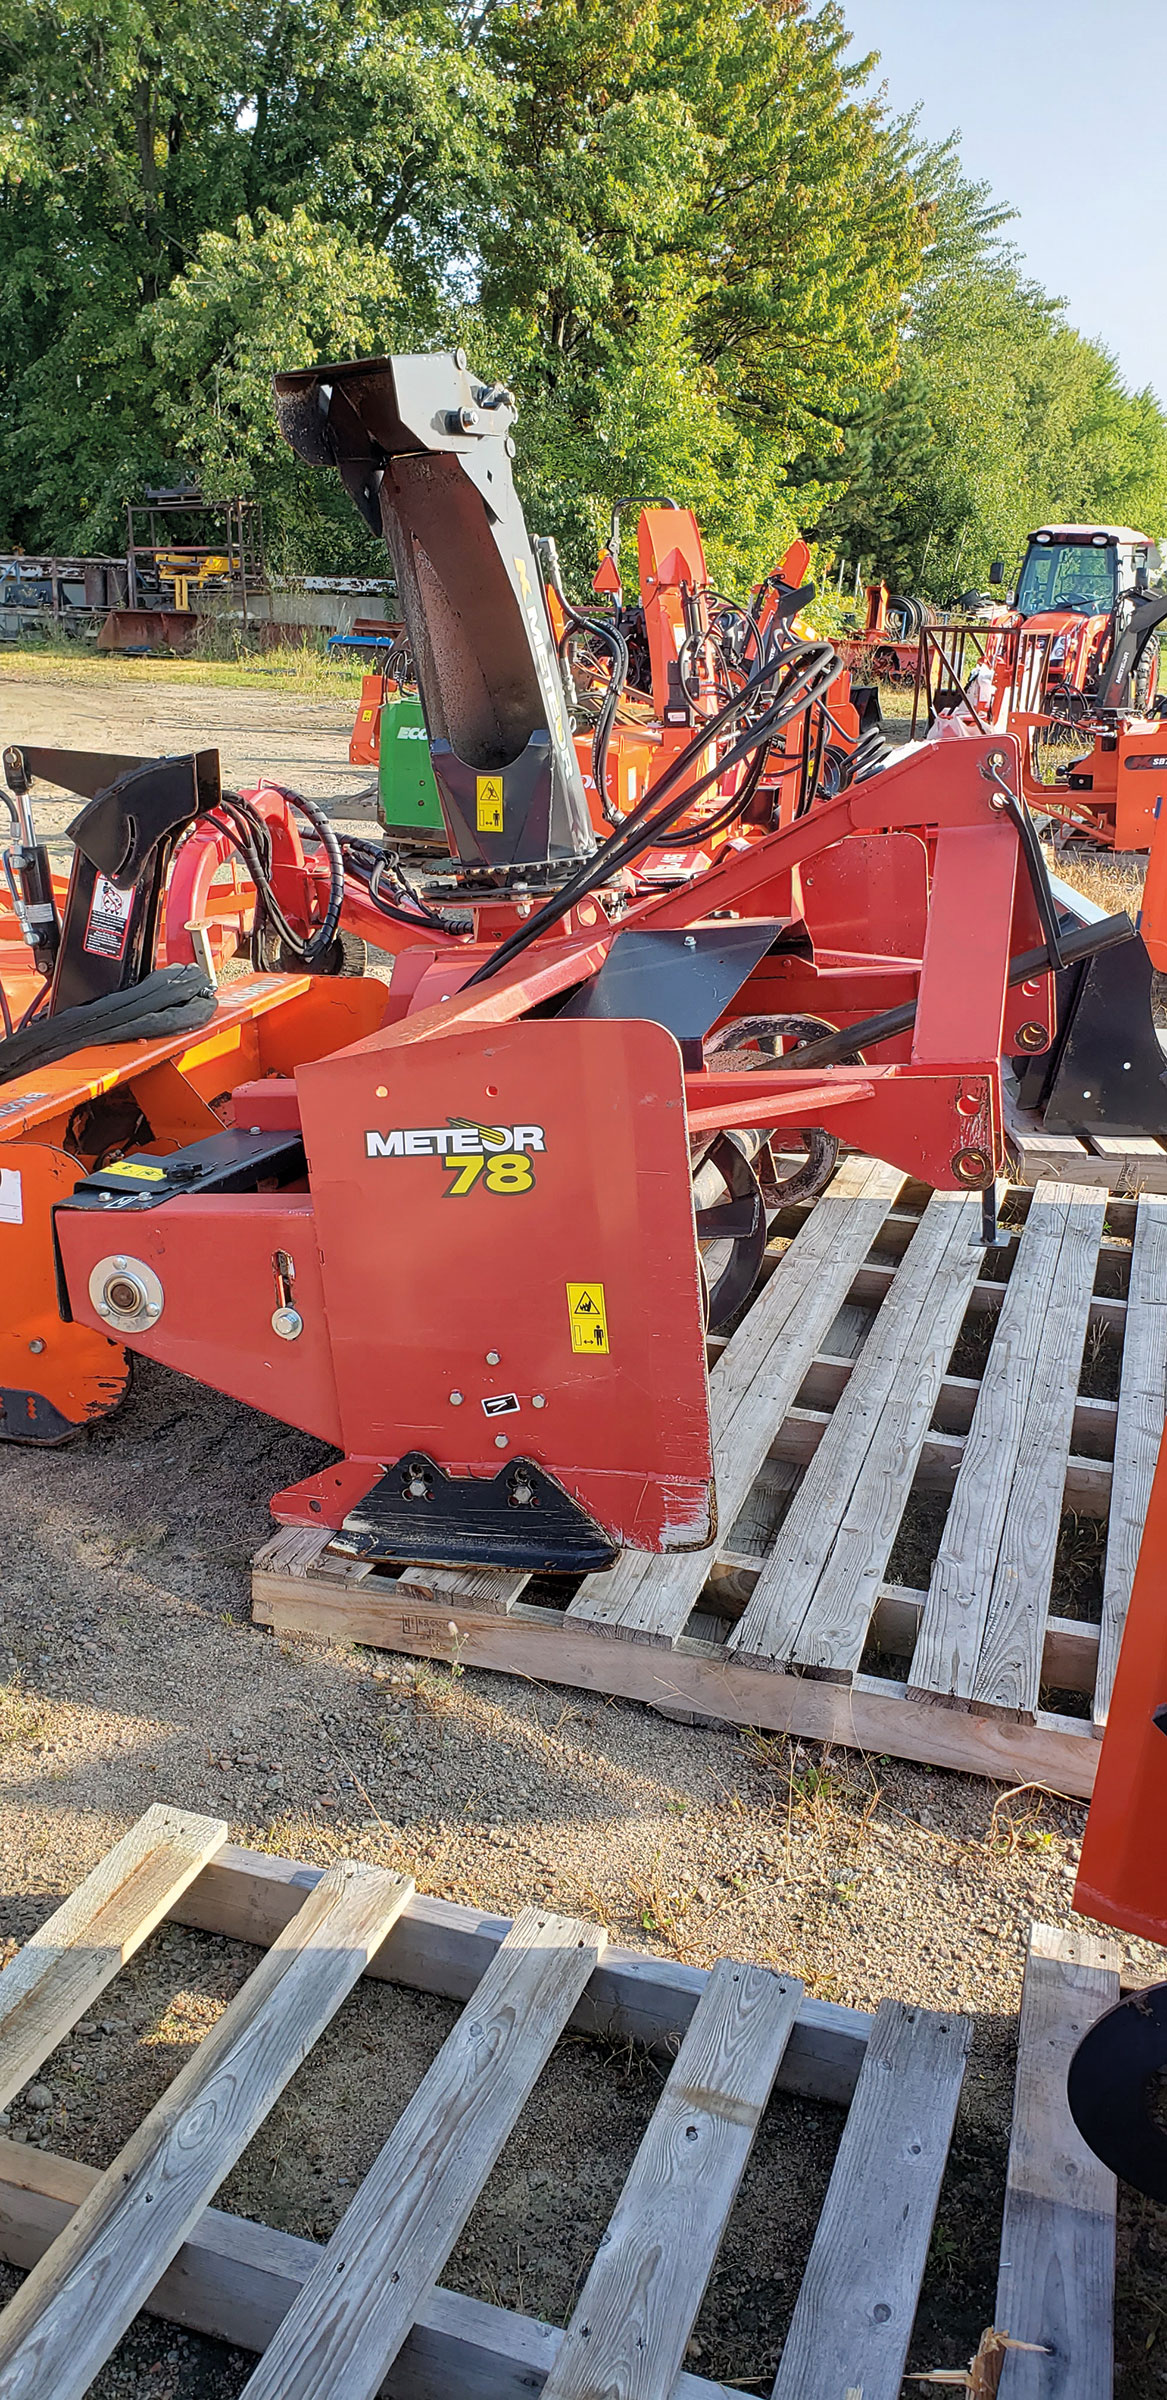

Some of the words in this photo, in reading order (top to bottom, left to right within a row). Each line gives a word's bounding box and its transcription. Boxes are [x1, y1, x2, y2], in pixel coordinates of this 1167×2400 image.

[526, 605, 574, 782] METEOR
[365, 1124, 546, 1157] METEOR
[445, 1153, 533, 1195] 78
